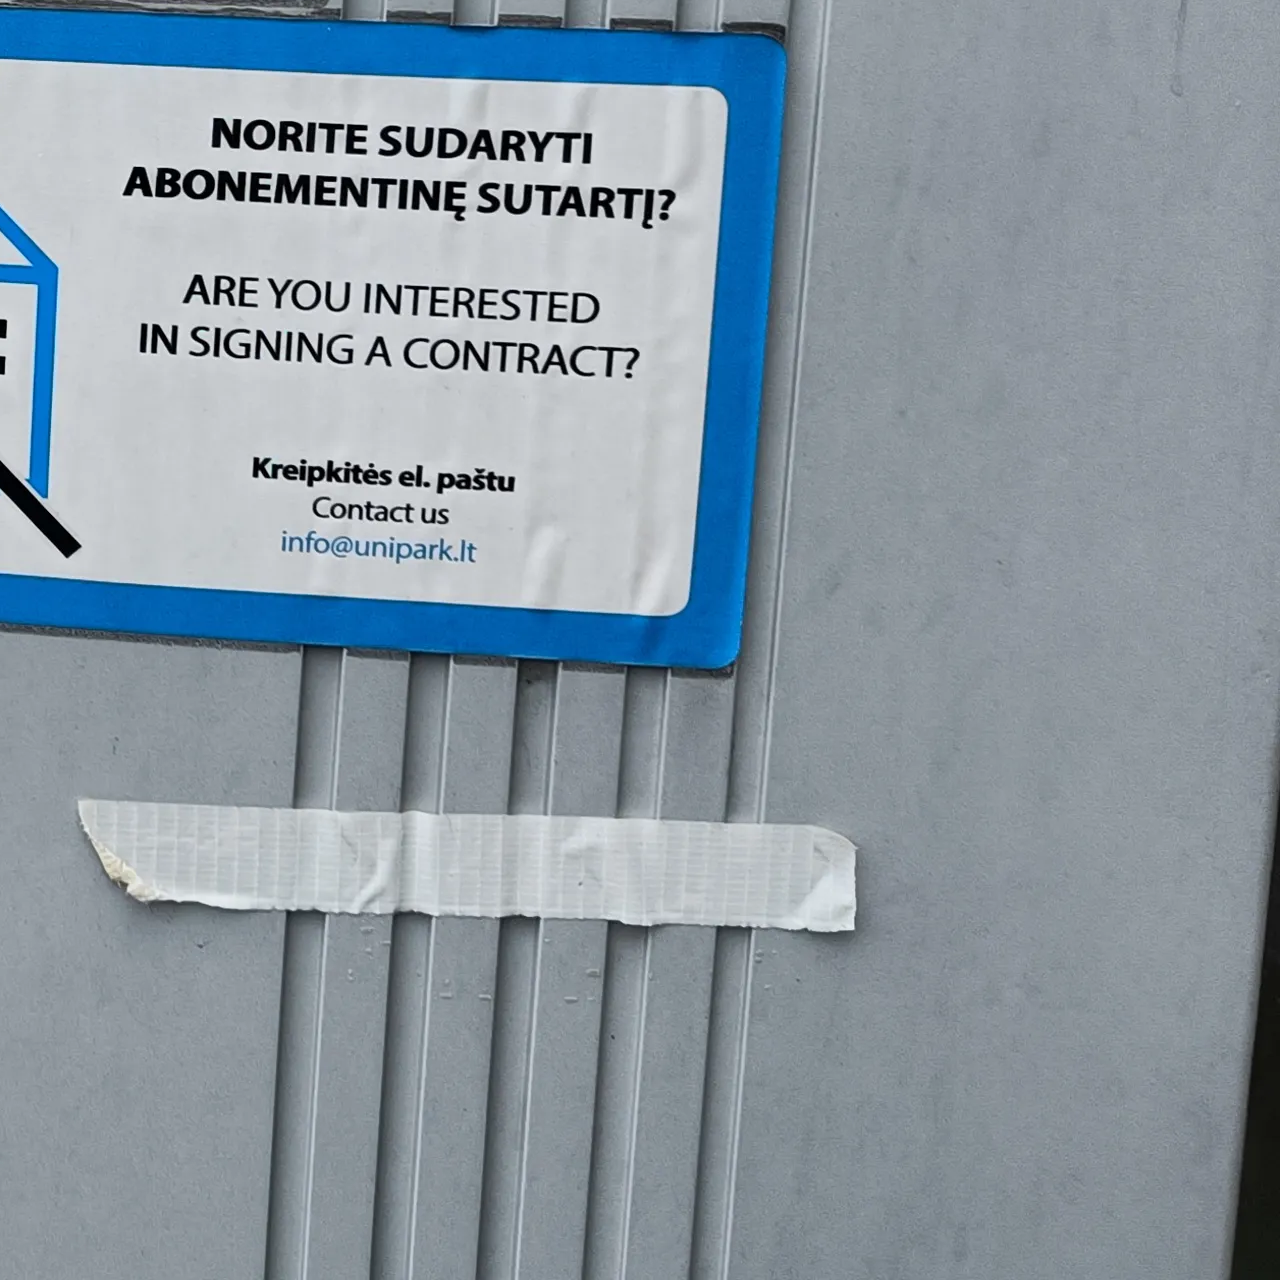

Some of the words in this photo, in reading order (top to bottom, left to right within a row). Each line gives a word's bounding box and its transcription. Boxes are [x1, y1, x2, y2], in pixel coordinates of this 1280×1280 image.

[211, 117, 369, 156] NORITE
[377, 124, 593, 165] SUDARYTI
[122, 166, 468, 222] ABONEMENTINĘ
[476, 182, 677, 230] SUTARTĮ?
[182, 273, 260, 308] ARE
[267, 277, 352, 313] YOU
[363, 282, 601, 324] INTERESTED
[139, 322, 179, 356] IN
[188, 325, 355, 365] SIGNING
[363, 335, 393, 368] A
[402, 337, 641, 379] CONTRACT?
[251, 456, 393, 488] Kreipkitės
[397, 464, 431, 488] el.
[435, 467, 516, 495] paštu
[311, 496, 416, 524] Contact
[420, 507, 450, 525] us
[281, 530, 478, 565] info@unipark.lt
